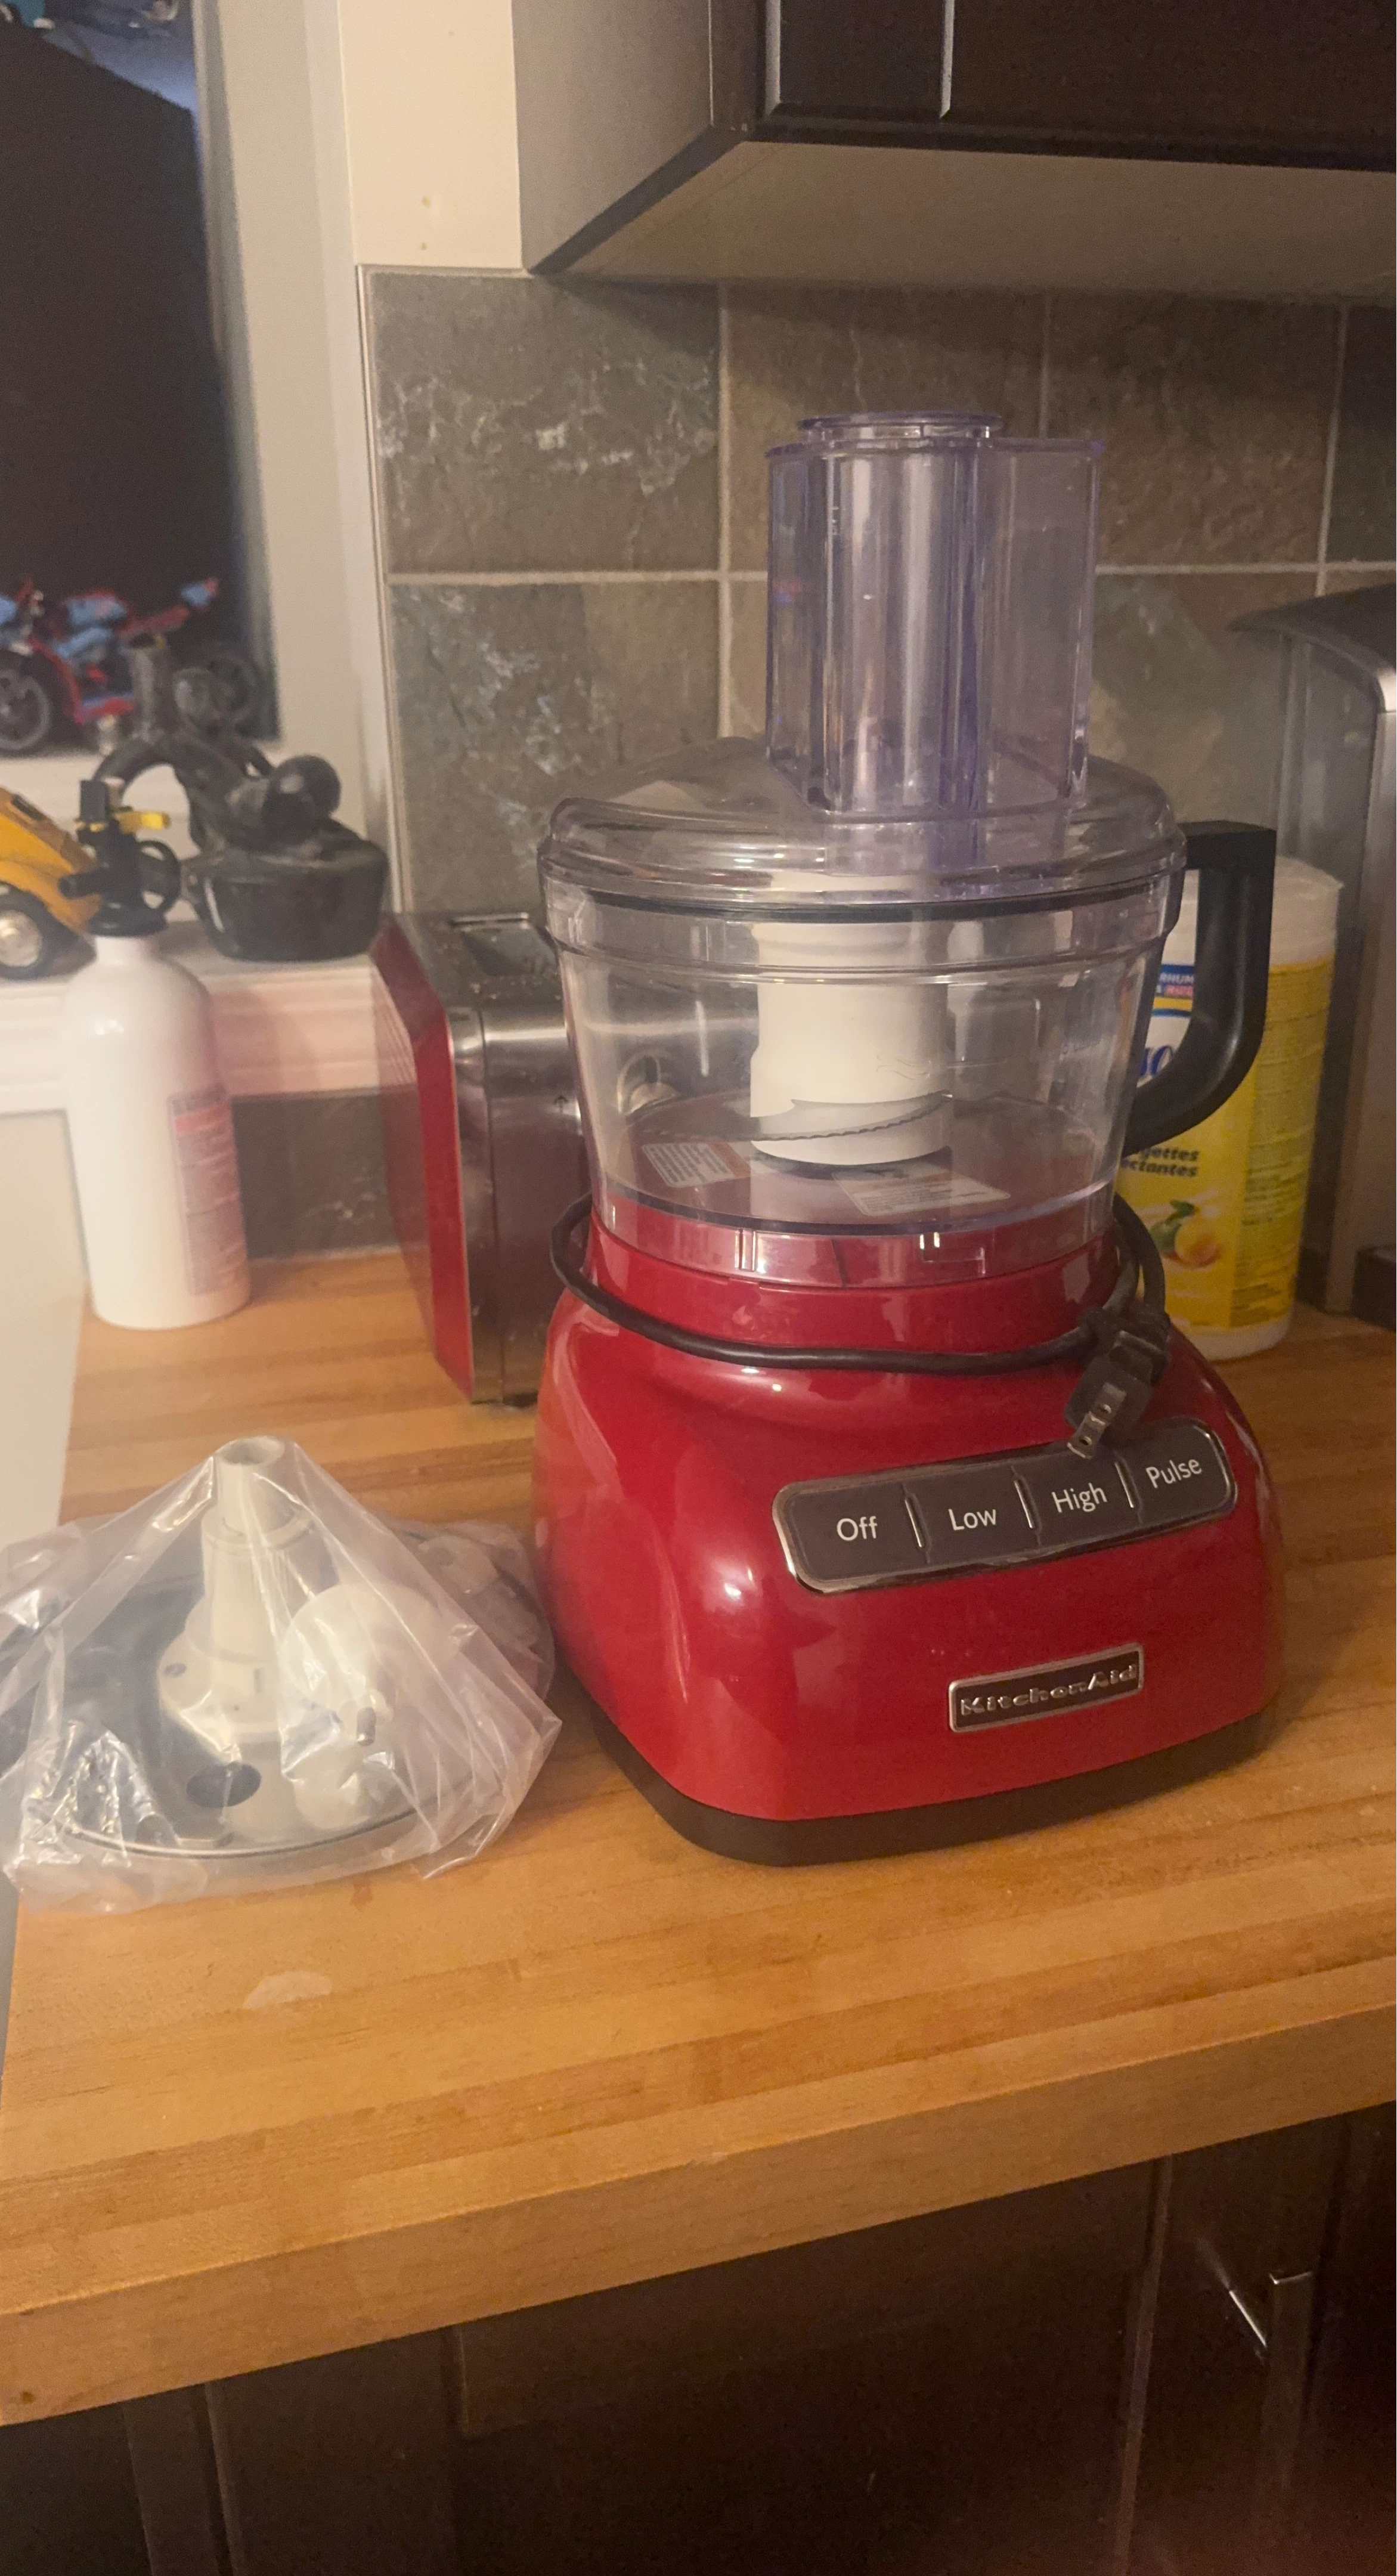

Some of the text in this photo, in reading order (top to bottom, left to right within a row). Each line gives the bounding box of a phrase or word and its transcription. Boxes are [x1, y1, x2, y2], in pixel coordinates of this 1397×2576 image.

[837, 1459, 1202, 1541] Off Low High Pulse
[960, 1664, 1137, 1716] KitchenAid
